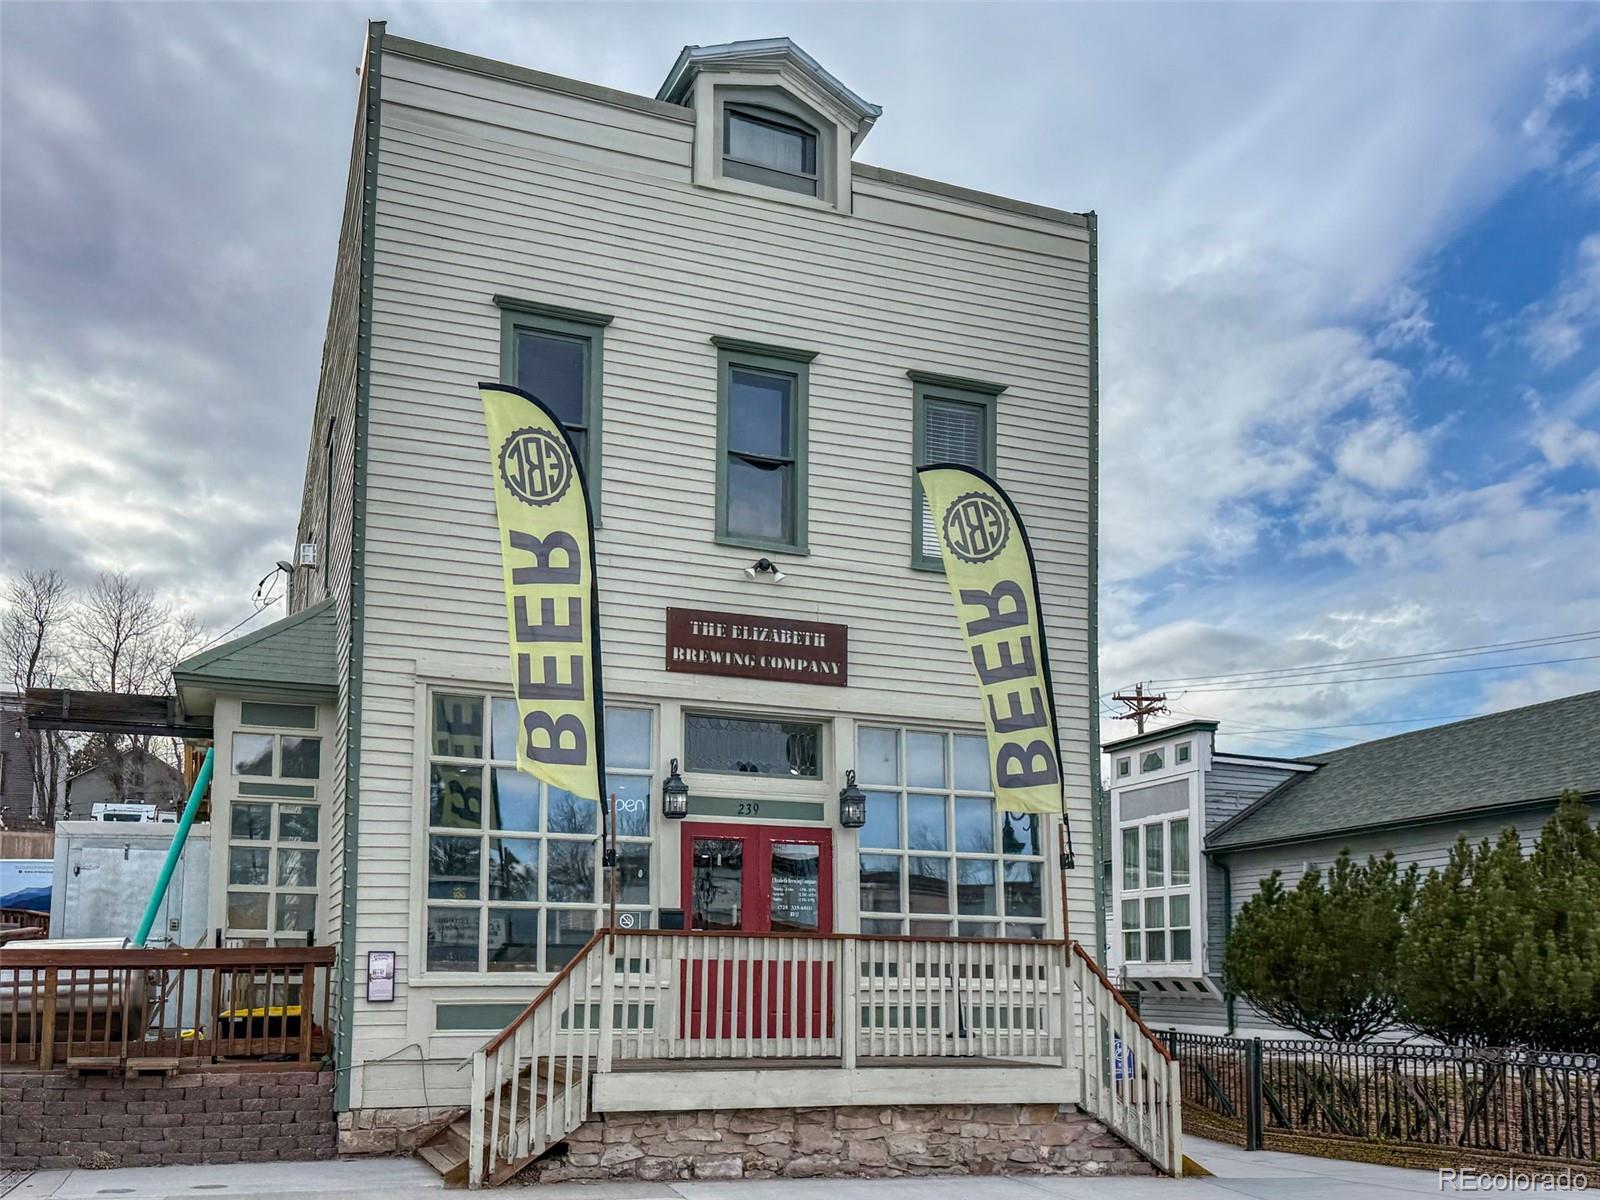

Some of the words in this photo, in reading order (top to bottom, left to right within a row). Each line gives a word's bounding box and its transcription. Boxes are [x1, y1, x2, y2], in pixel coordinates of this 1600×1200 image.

[690, 620, 727, 638] THE
[732, 624, 826, 648] ELIZABETH
[672, 646, 756, 668] BREWING
[760, 655, 841, 675] COMPANY
[606, 798, 645, 813] pen
[738, 803, 759, 815] 239
